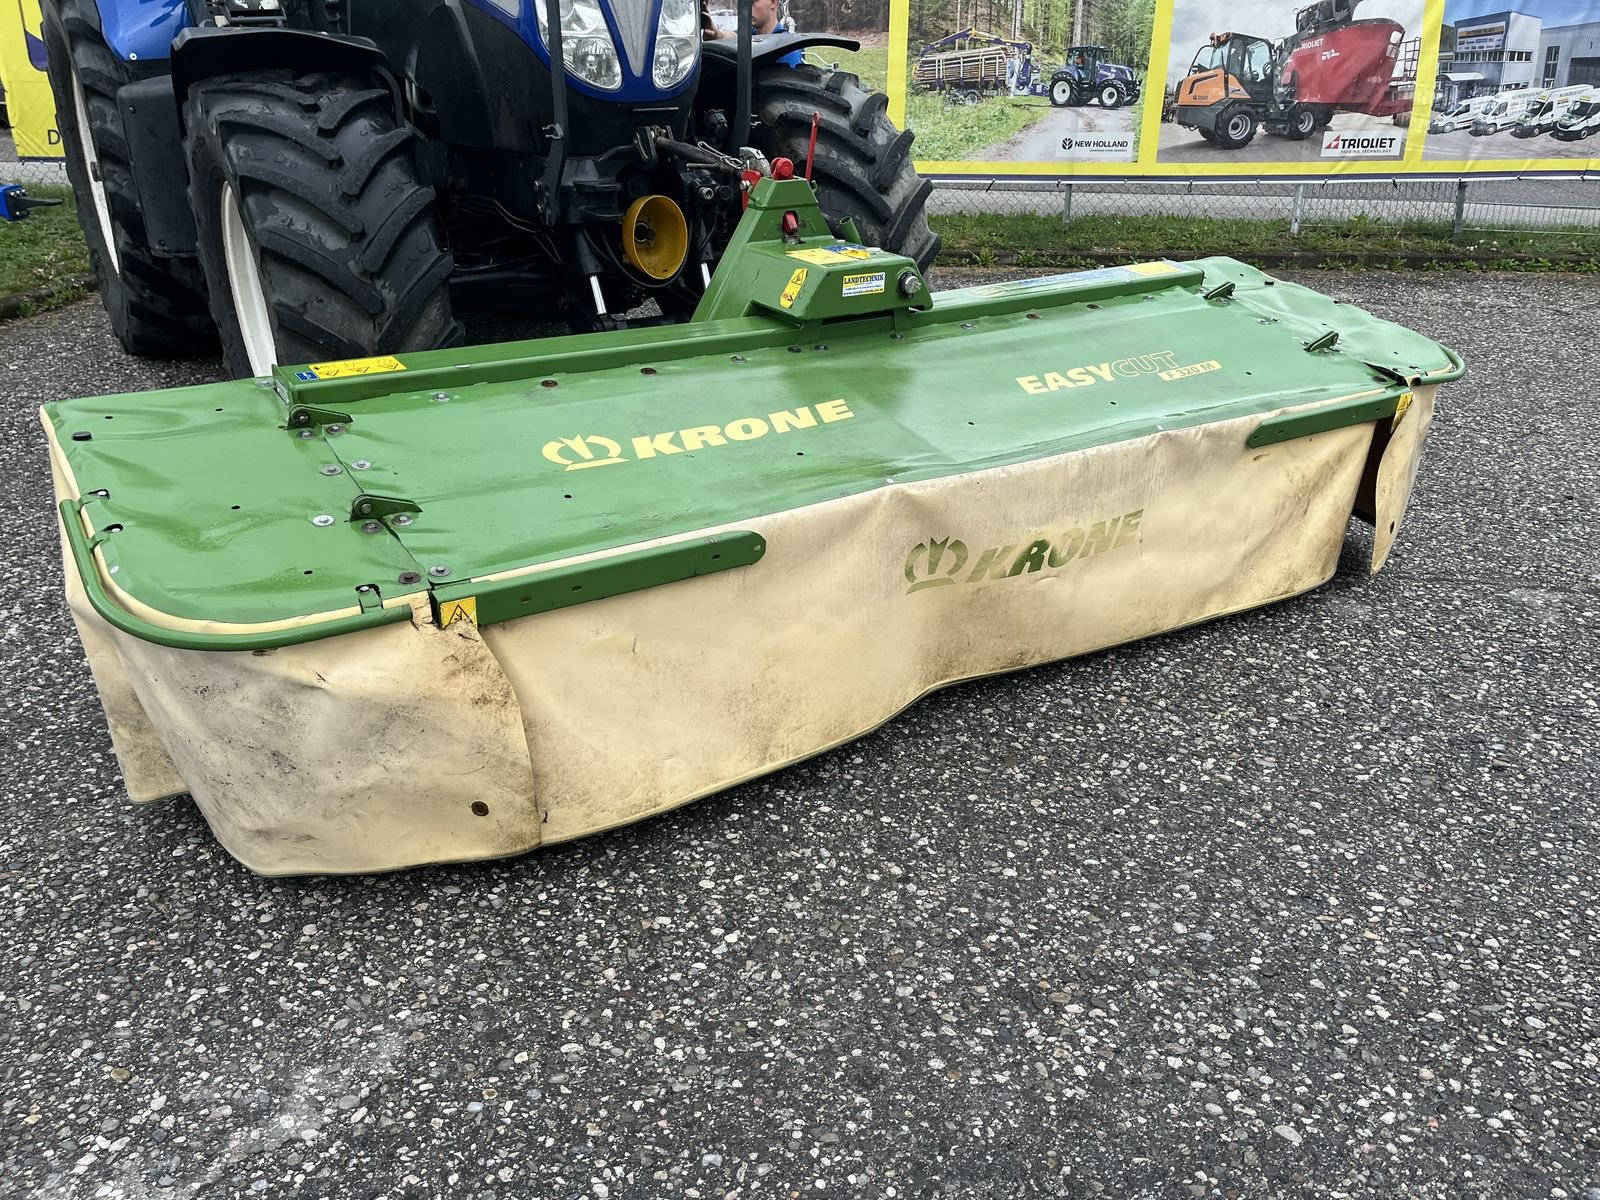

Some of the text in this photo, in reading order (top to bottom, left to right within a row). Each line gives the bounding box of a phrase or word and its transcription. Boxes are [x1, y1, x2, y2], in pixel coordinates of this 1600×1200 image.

[48, 129, 60, 145] D
[1093, 140, 1128, 148] HOLLAND
[1341, 138, 1396, 149] TRIOLIET
[844, 274, 884, 284] LANDTECHNIK
[1166, 362, 1215, 380] F 320 M
[631, 398, 855, 460] KRONE
[965, 508, 1144, 583] KRONE
